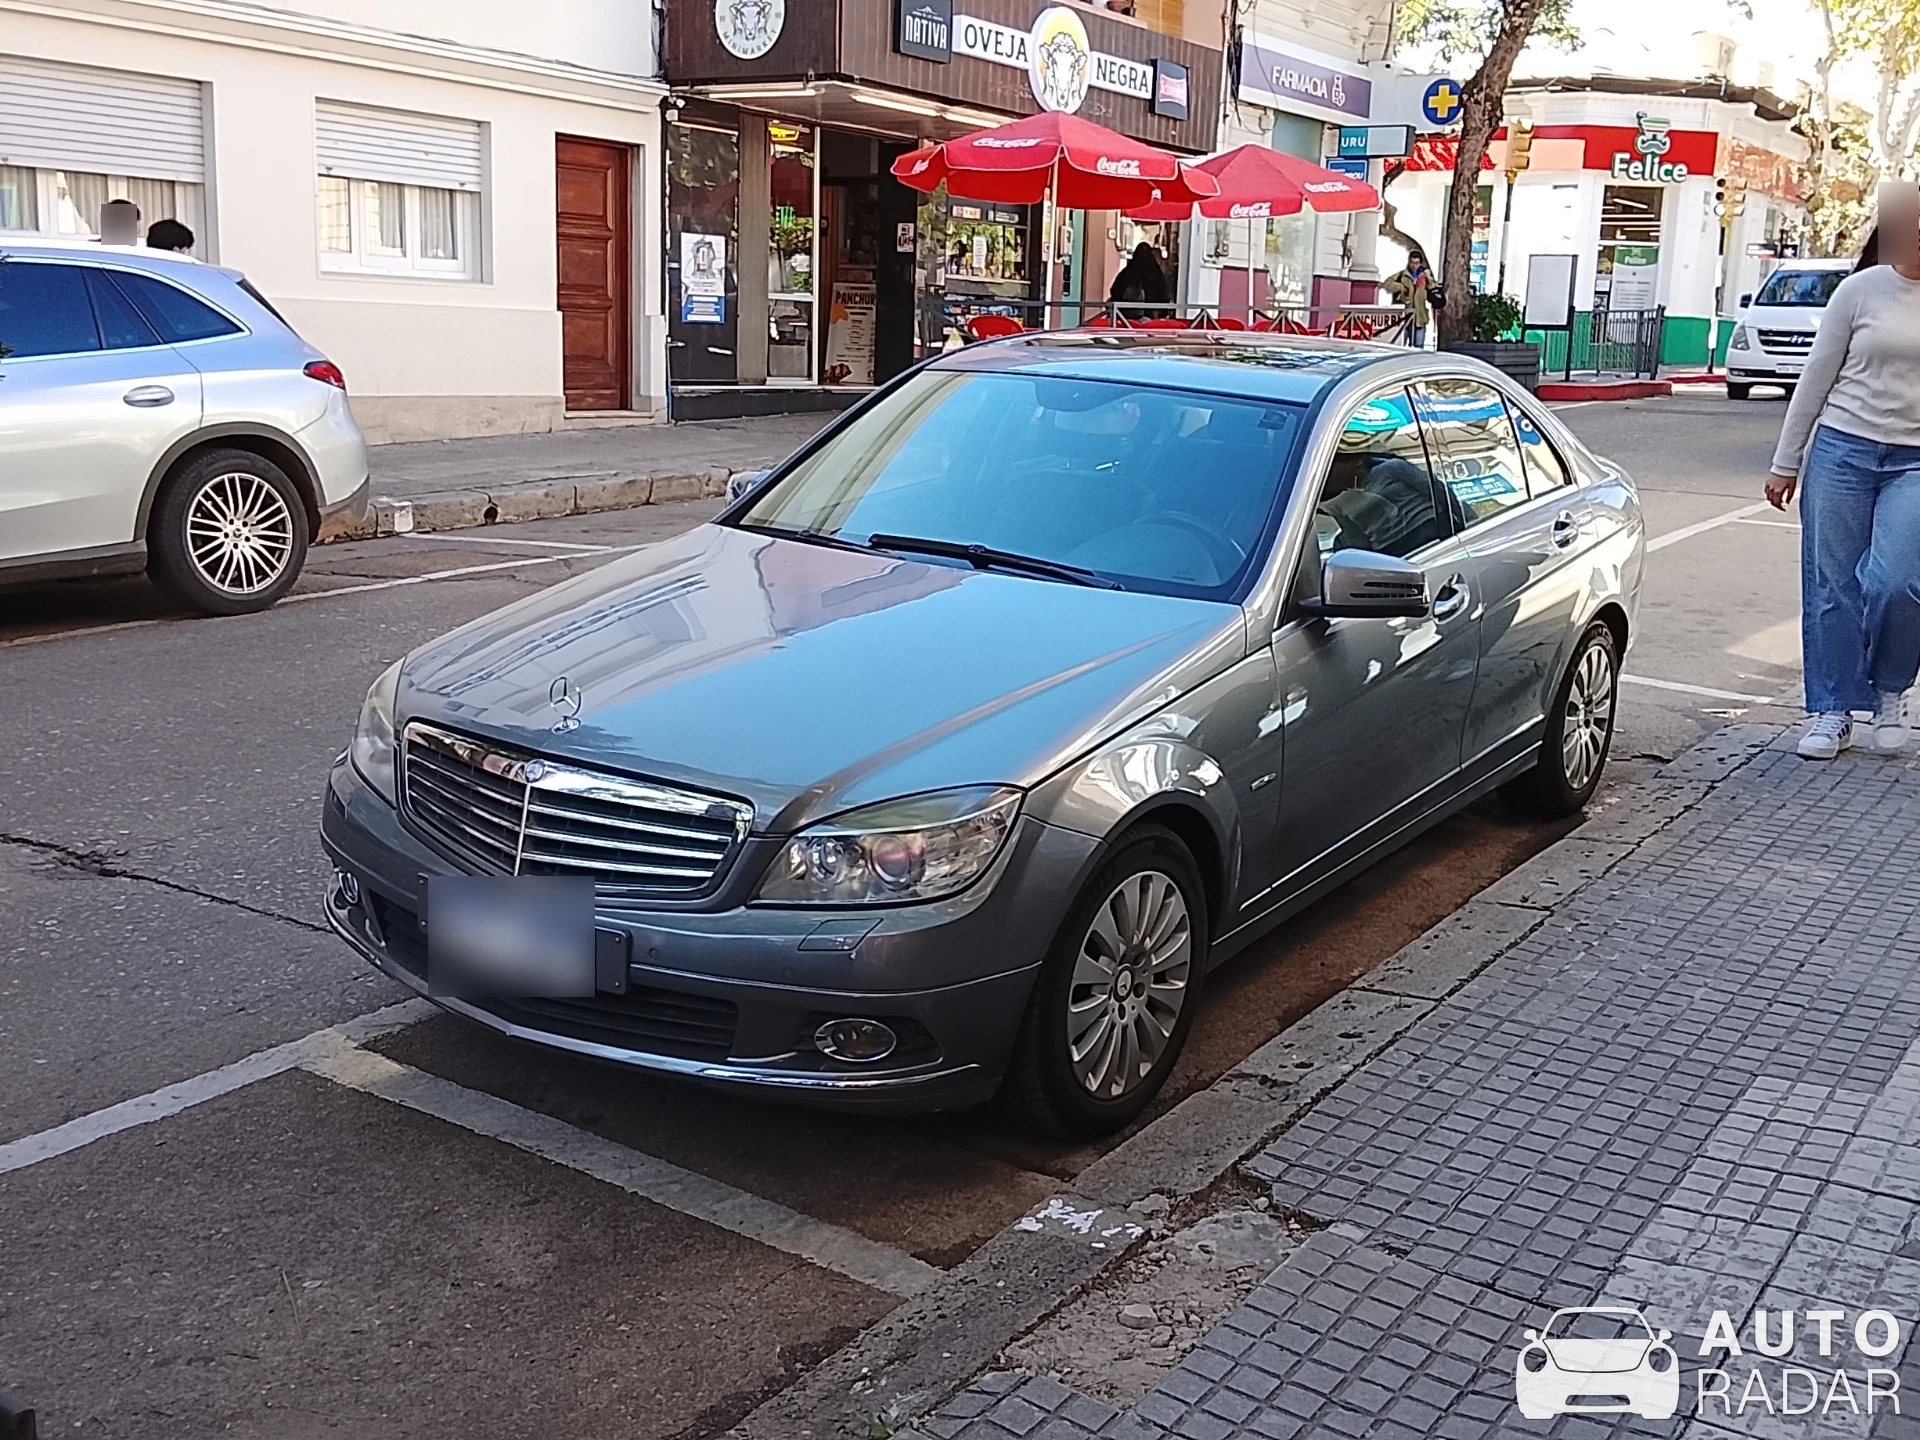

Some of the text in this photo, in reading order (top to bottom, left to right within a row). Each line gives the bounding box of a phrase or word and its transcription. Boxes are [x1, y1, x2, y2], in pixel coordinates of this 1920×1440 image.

[722, 29, 777, 55] MINIMARKET
[905, 14, 949, 50] NATIVA
[964, 24, 1029, 63] OVEJA
[1096, 57, 1150, 94] NEGRA
[1271, 65, 1329, 99] FARMACIA
[1341, 136, 1366, 148] URU
[1612, 151, 1688, 182] Felice
